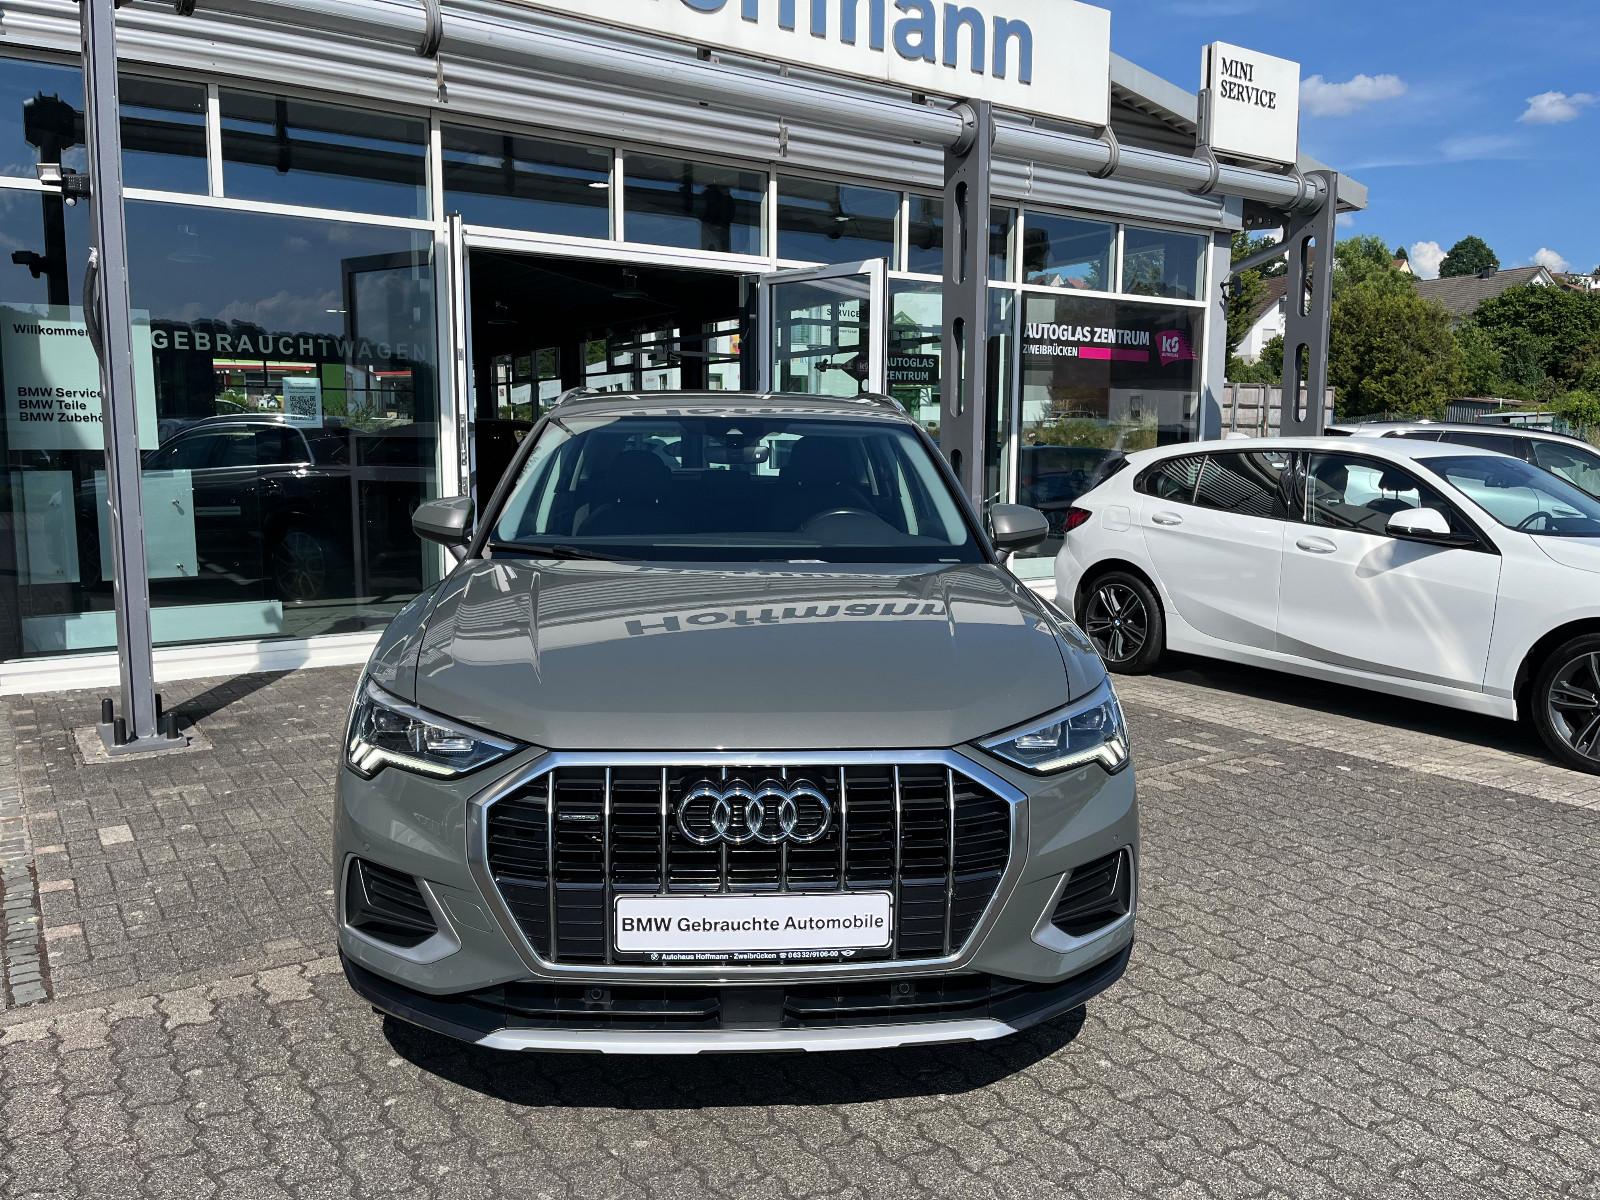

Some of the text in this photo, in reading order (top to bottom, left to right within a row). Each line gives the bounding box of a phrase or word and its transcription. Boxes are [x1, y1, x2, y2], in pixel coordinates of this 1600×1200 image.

[1221, 57, 1254, 82] MINI
[1221, 79, 1276, 109] SERVICE
[826, 308, 860, 318] SRVICE
[1024, 323, 1150, 345] AUTOGLAS ZENTRUM
[151, 329, 426, 360] GEBRAUCHTWAGEN
[1023, 343, 1078, 357] ZWEIBRÜCKEN
[17, 387, 53, 397] BMW
[19, 400, 87, 410] BMW Teile
[20, 412, 55, 422] BMW
[622, 914, 884, 932] BMW Gebrauchte Automobile
